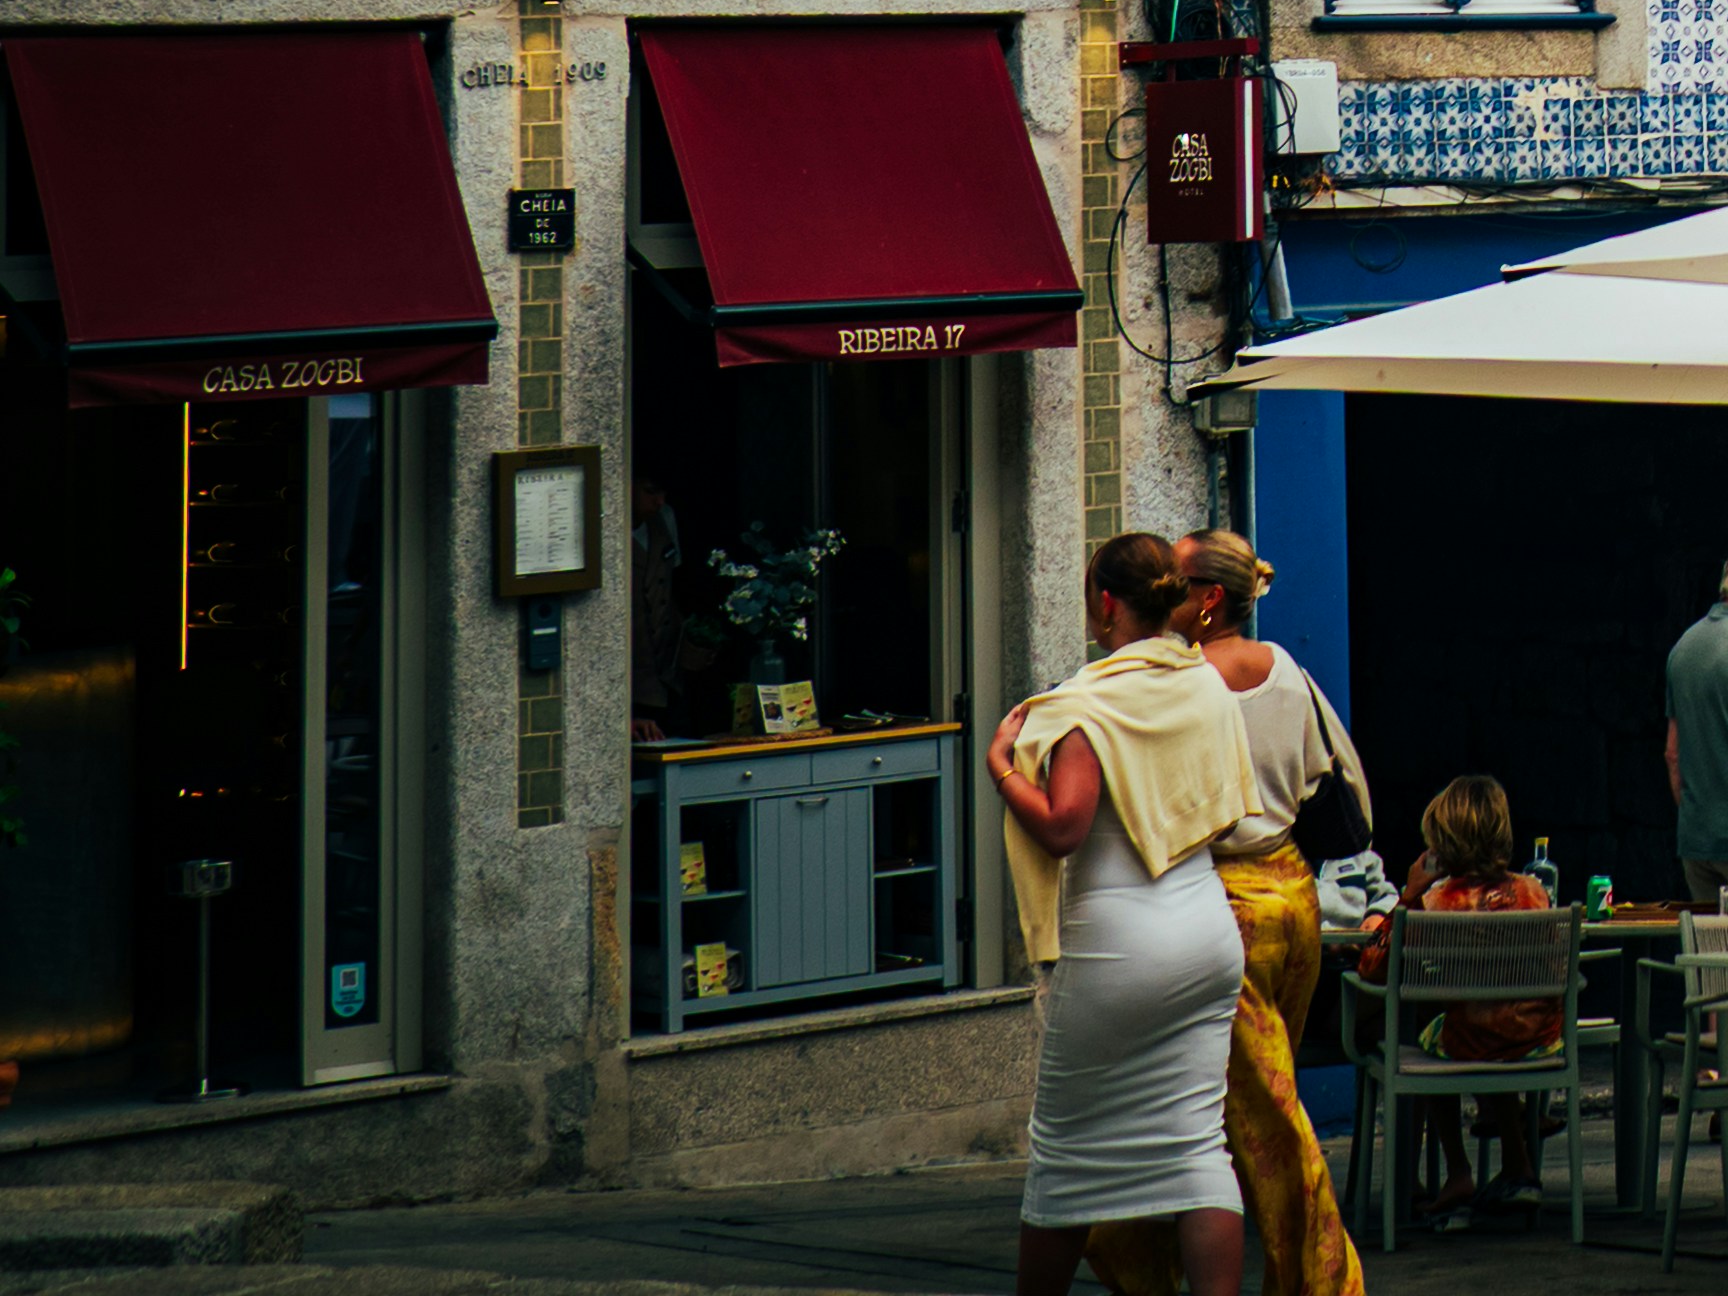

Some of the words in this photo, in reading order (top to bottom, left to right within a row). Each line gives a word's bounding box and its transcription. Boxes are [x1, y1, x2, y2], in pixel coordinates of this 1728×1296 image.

[462, 64, 529, 89] CHEIA
[554, 61, 606, 85] 1909
[1171, 133, 1209, 158] CASA
[1169, 157, 1213, 182] ZOGBI
[520, 199, 567, 213] CHEIA
[535, 218, 550, 228] DE
[528, 232, 557, 245] 1962
[838, 326, 939, 355] RIBEIRA
[944, 324, 966, 351] 17
[203, 363, 275, 393] CASA
[280, 357, 364, 389] ZOGBI
